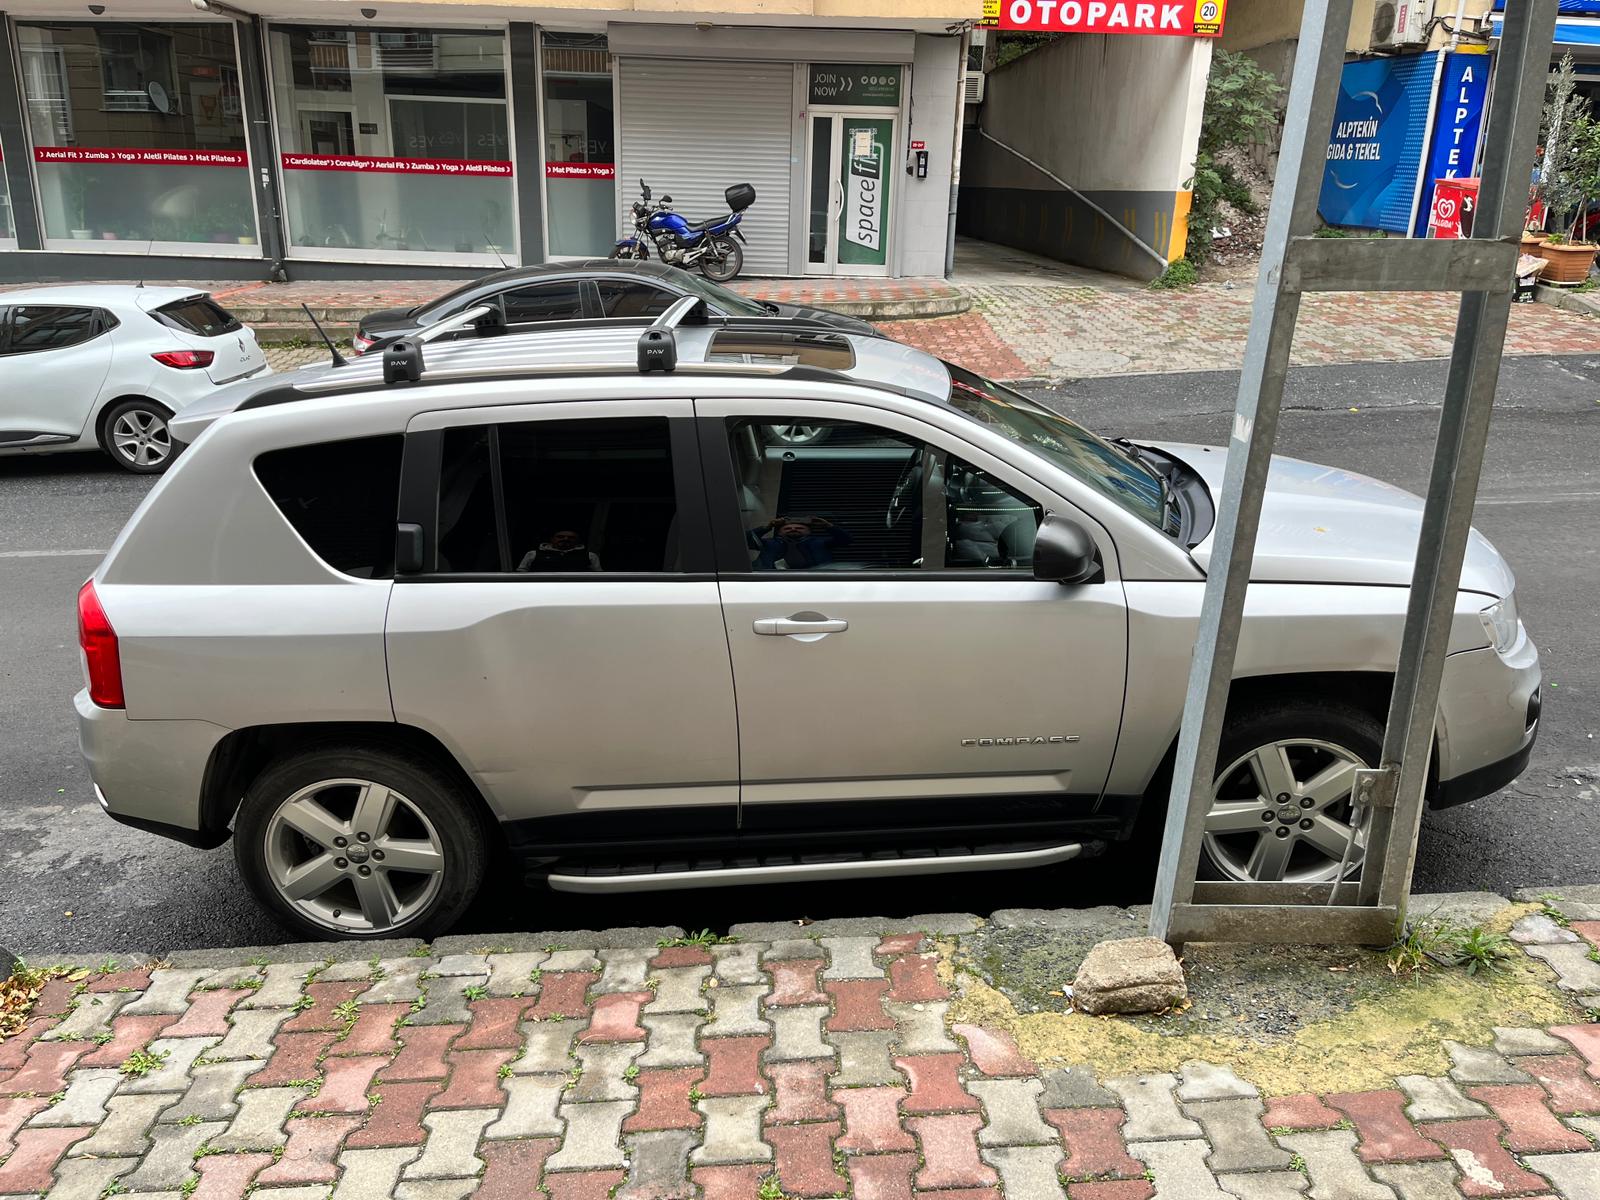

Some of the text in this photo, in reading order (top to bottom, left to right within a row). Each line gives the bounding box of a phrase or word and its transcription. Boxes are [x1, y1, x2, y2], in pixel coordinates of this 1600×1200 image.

[1009, 0, 1184, 29] OTOPARK
[1203, 5, 1215, 17] 20
[814, 73, 837, 84] JOIN
[814, 86, 838, 97] NOW
[1336, 115, 1379, 138] ALPTEKİN
[117, 152, 135, 160] Yoga
[1326, 143, 1381, 160] GIDA & TEKEL
[411, 162, 435, 170] Zumba
[441, 163, 458, 171] Yoga
[565, 166, 587, 174] Pilates
[592, 167, 610, 175] Yoga
[858, 179, 878, 243] space
[960, 735, 1080, 747] COMPASS
